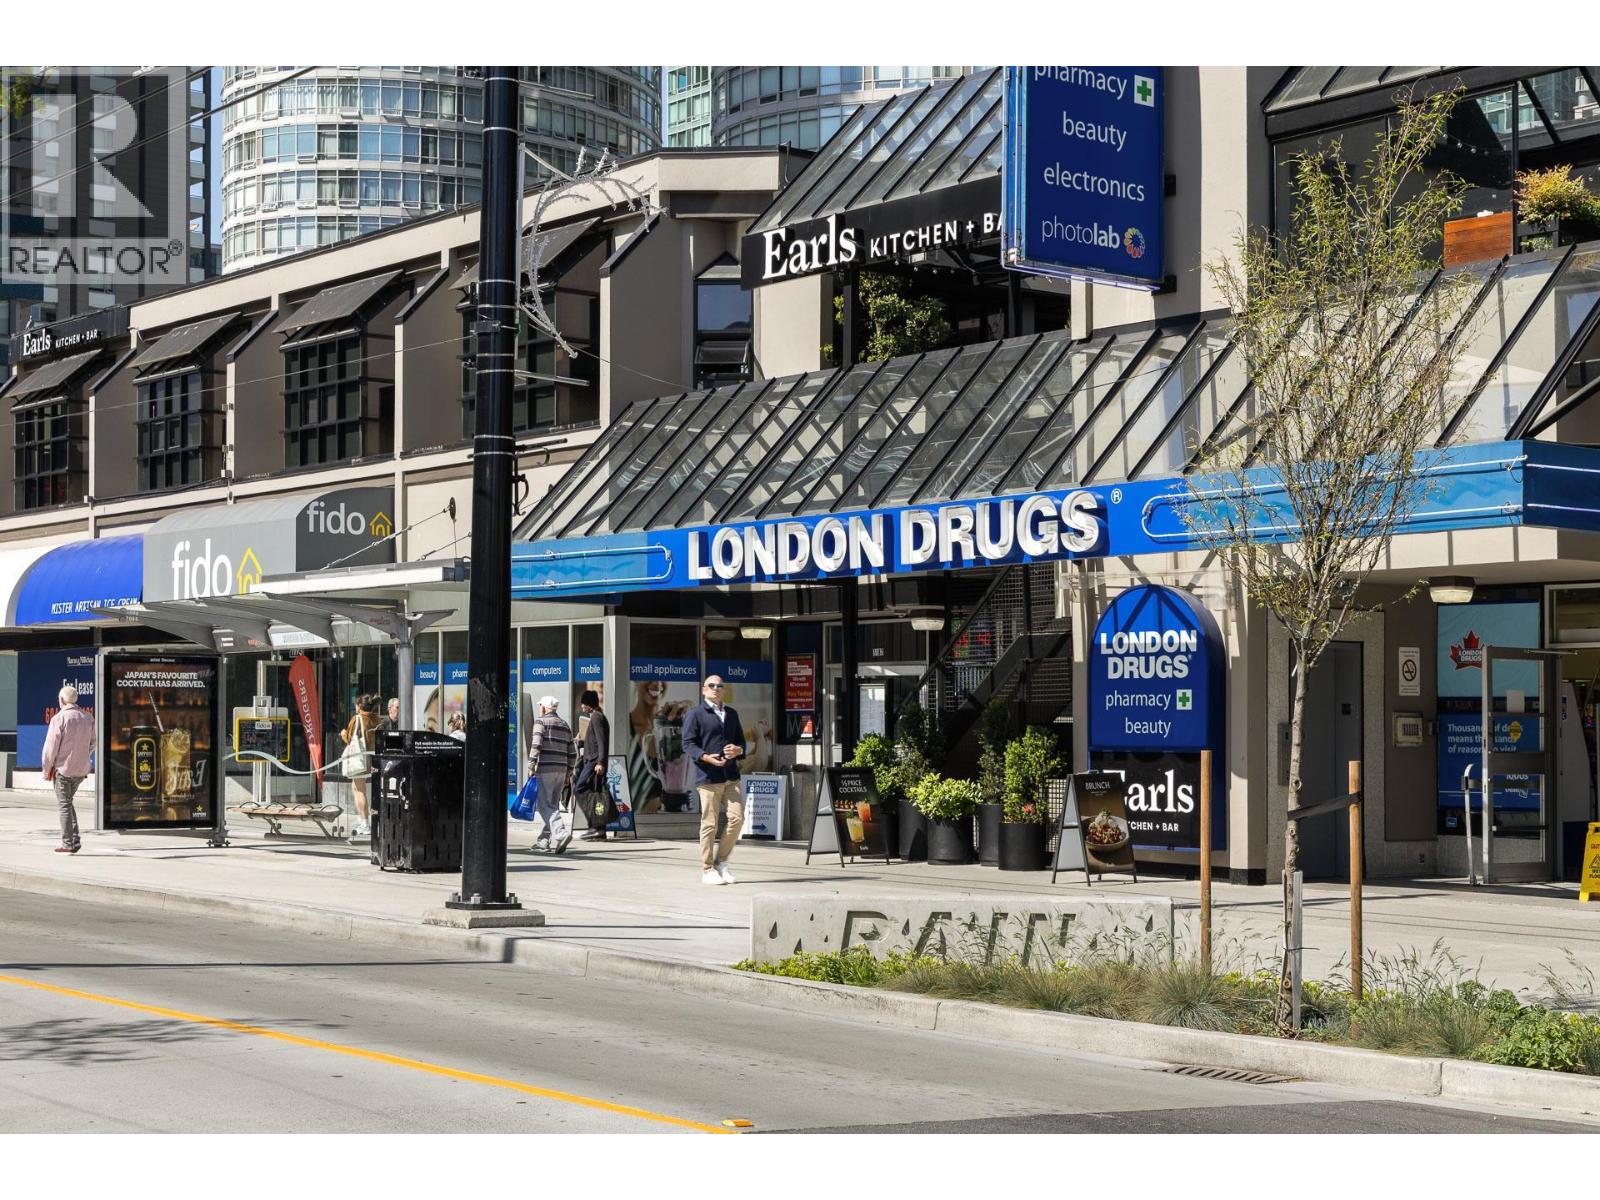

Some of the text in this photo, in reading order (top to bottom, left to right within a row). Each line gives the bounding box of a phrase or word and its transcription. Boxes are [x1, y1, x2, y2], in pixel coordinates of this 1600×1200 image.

[1033, 66, 1128, 100] pharmacy
[1062, 111, 1127, 152] beauty
[1043, 162, 1145, 202] electronics
[1041, 216, 1121, 249] photolab
[762, 213, 857, 280] Earls
[870, 219, 958, 257] KITCHEN
[23, 328, 51, 356] Earls
[55, 334, 80, 348] KITCHEN
[86, 329, 98, 341] BAR
[305, 500, 366, 536] fido
[687, 513, 885, 580] LONDON
[901, 490, 1099, 566] DRUGS
[171, 538, 232, 601] fido
[51, 602, 73, 615] MISTER
[75, 599, 101, 613] ARTISAN
[104, 599, 115, 608] ICE
[1100, 629, 1197, 655] LONDON
[532, 666, 562, 676] computers
[580, 664, 601, 674] mobile
[631, 664, 697, 677] small appliances
[728, 666, 748, 678] baby
[1107, 654, 1189, 680] DRUGS
[125, 671, 198, 680] JAPAN'S FAVOURITE
[420, 669, 437, 680] beauty
[452, 669, 468, 680] pharm
[116, 679, 206, 688] COCKTAIL HAS ARRIVED.
[1105, 690, 1172, 711] pharmacy
[1125, 717, 1172, 738] beauty
[1447, 723, 1483, 733] Thousan
[1447, 736, 1474, 744] means
[1447, 745, 1456, 753] of
[839, 786, 868, 794] COCKTAILS
[1085, 781, 1111, 790] BRUNCH
[1128, 821, 1153, 831] CHEN
[1162, 822, 1179, 831] BAR
